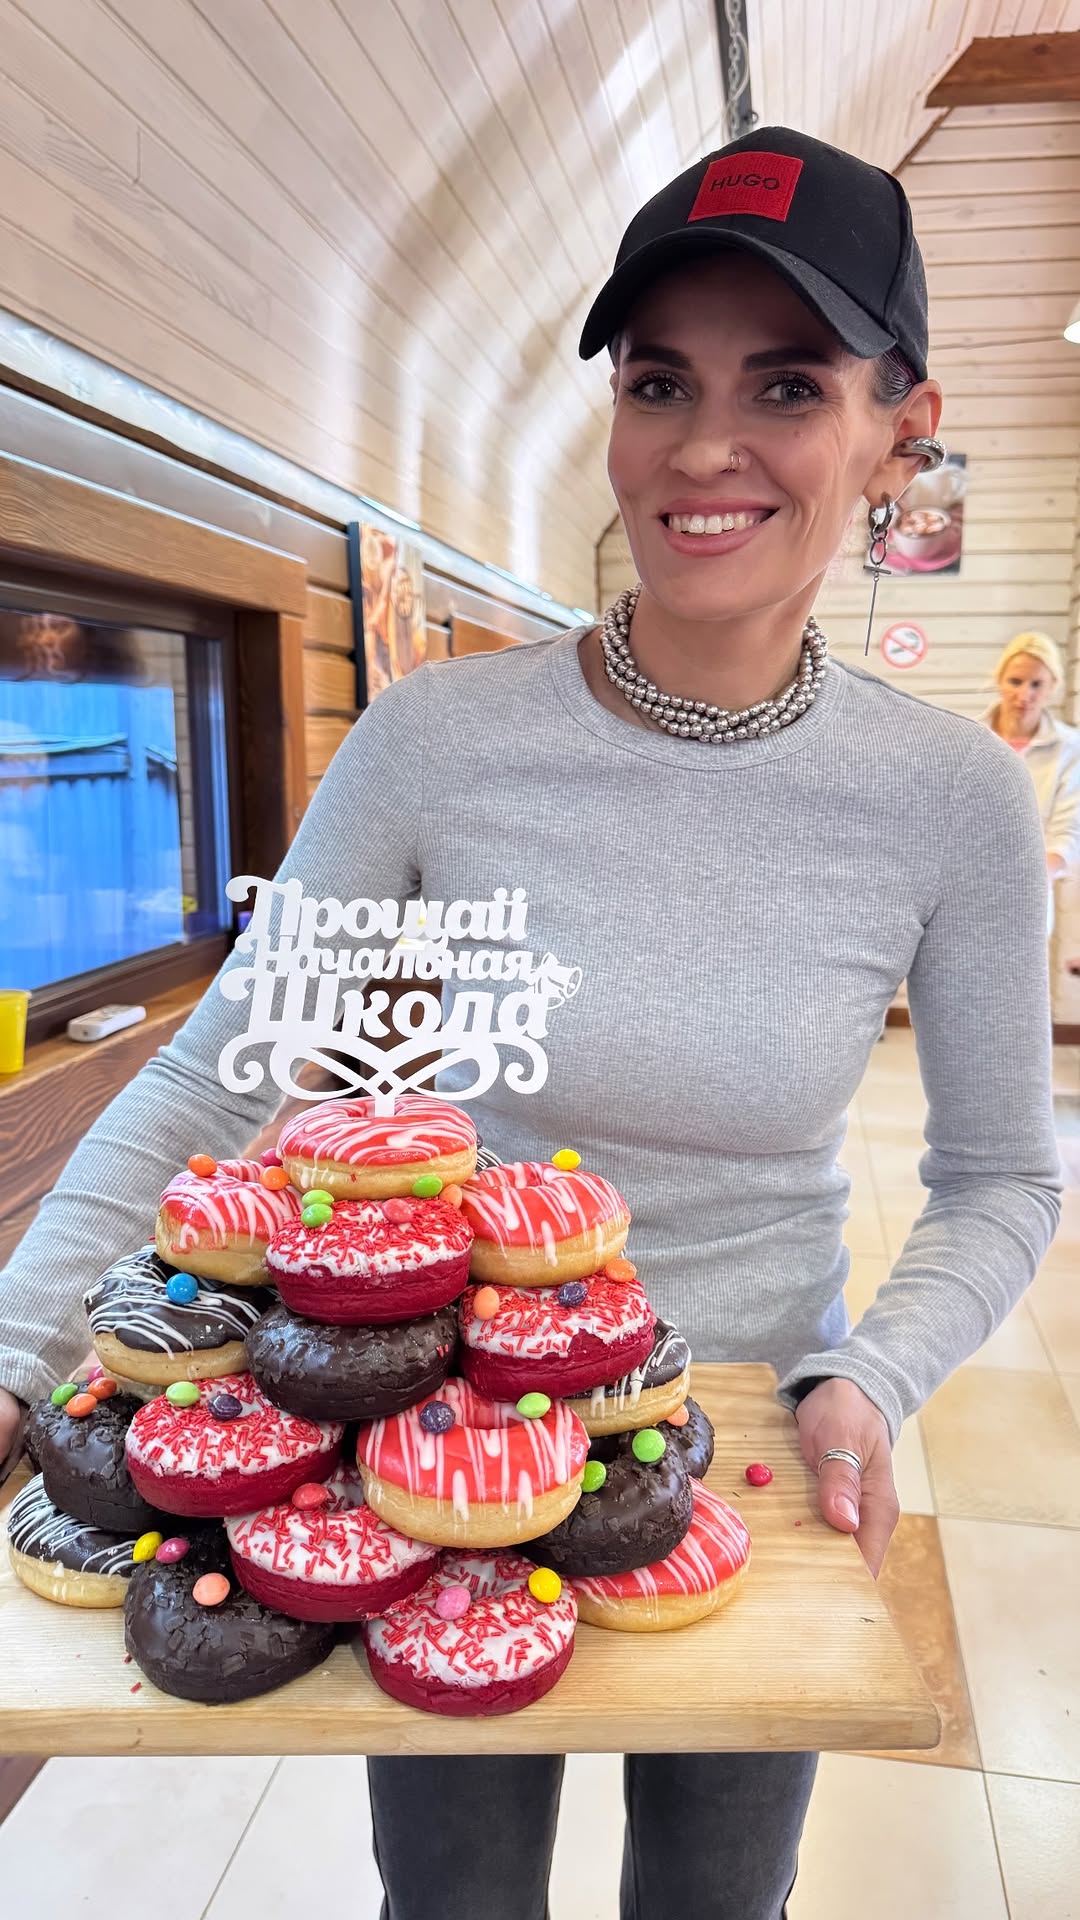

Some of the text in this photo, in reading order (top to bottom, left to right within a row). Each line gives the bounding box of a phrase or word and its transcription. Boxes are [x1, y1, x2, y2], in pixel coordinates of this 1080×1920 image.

[710, 173, 780, 192] HUGO
[225, 875, 529, 949] Прощай
[235, 932, 538, 986] Начальная
[220, 967, 549, 1040] Школа
